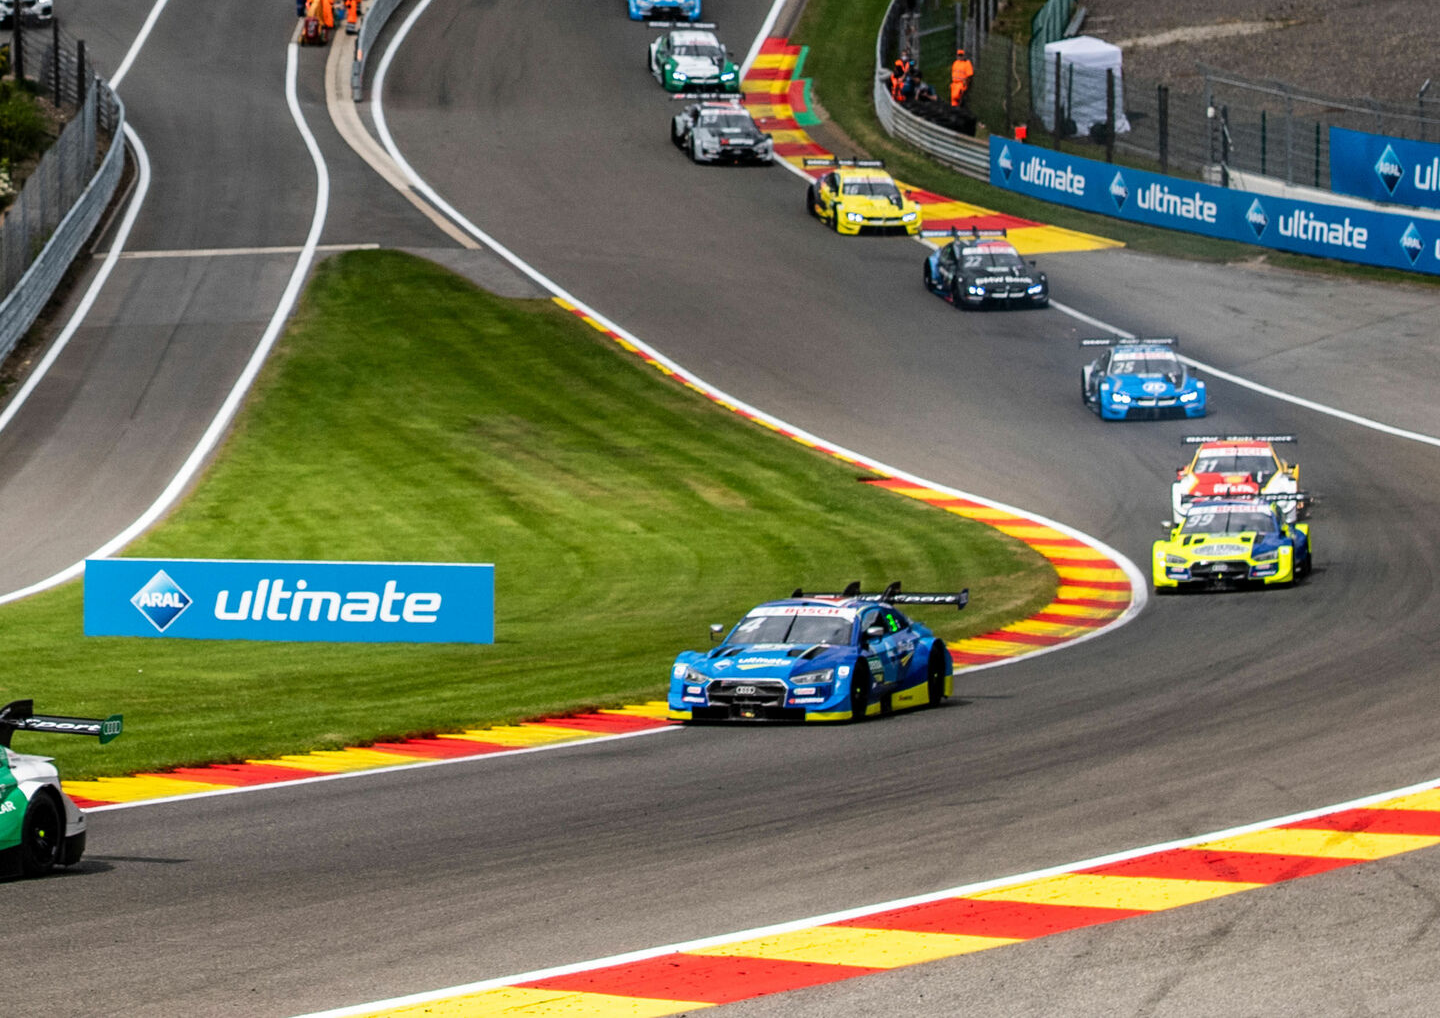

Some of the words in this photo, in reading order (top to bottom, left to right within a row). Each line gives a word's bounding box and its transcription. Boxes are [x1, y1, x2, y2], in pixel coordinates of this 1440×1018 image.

[1020, 155, 1085, 196] ultimate
[1378, 161, 1401, 177] ARAL
[1137, 182, 1217, 224] ultimate
[1278, 208, 1368, 250] ultimate
[1402, 236, 1422, 250] ARAL
[964, 256, 983, 267] 22
[1114, 362, 1135, 373] 25
[1195, 459, 1218, 472] 31
[1186, 514, 1215, 527] 99
[138, 592, 184, 608] ARAL
[214, 578, 442, 623] ultimate
[784, 607, 840, 615] BOSCH
[737, 657, 792, 666] ultimate
